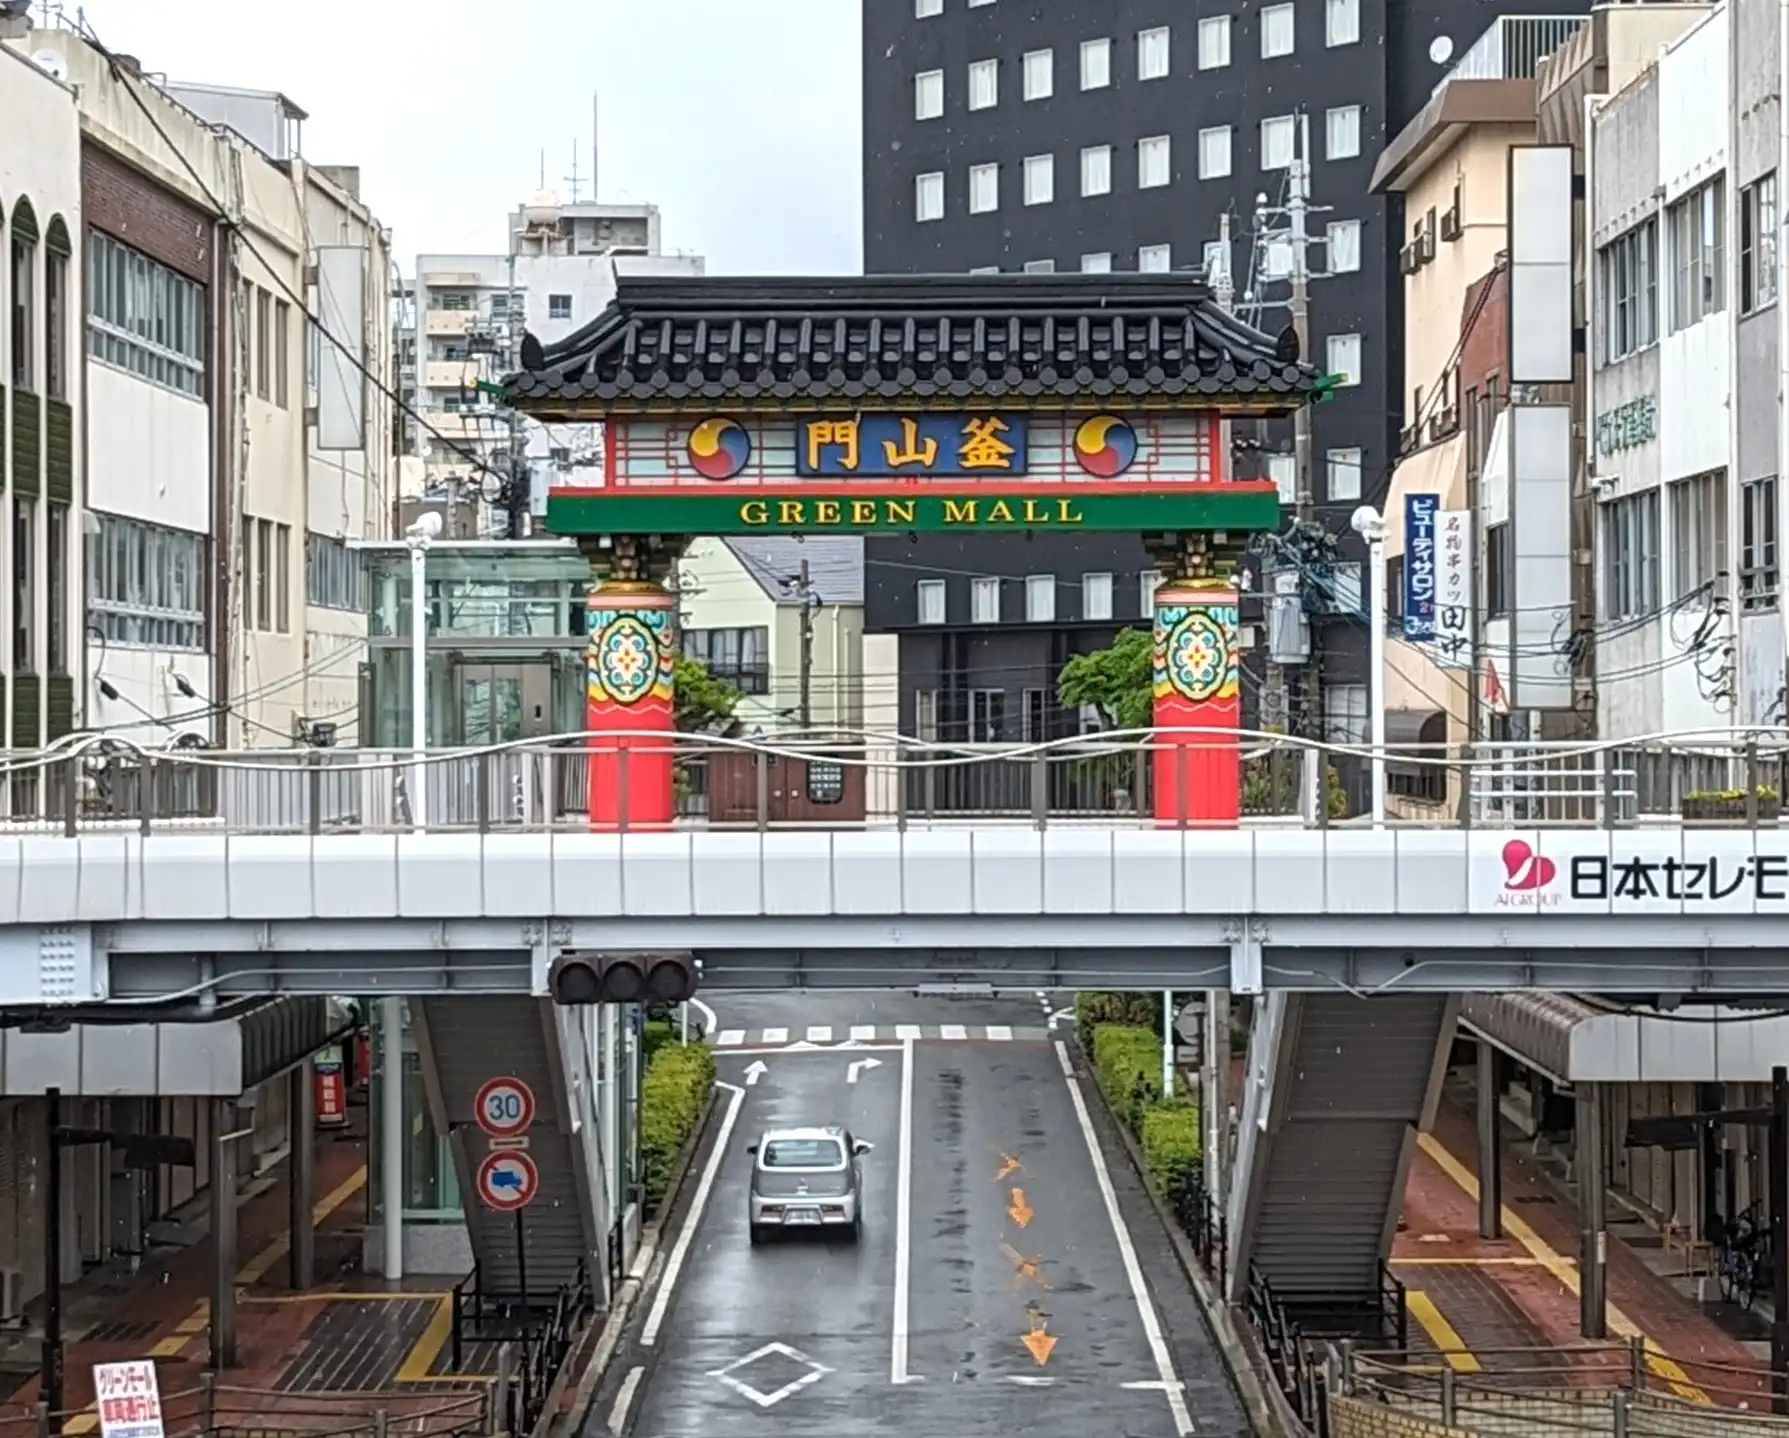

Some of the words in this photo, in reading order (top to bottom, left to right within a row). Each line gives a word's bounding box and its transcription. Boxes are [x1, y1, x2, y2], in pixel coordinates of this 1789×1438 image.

[740, 501, 916, 524] GREEN
[942, 501, 1083, 523] MALL
[1411, 499, 1433, 600] ビューティサロン
[1441, 605, 1468, 662] 田中
[489, 1094, 520, 1120] 30
[100, 1366, 154, 1394] グリーンモール
